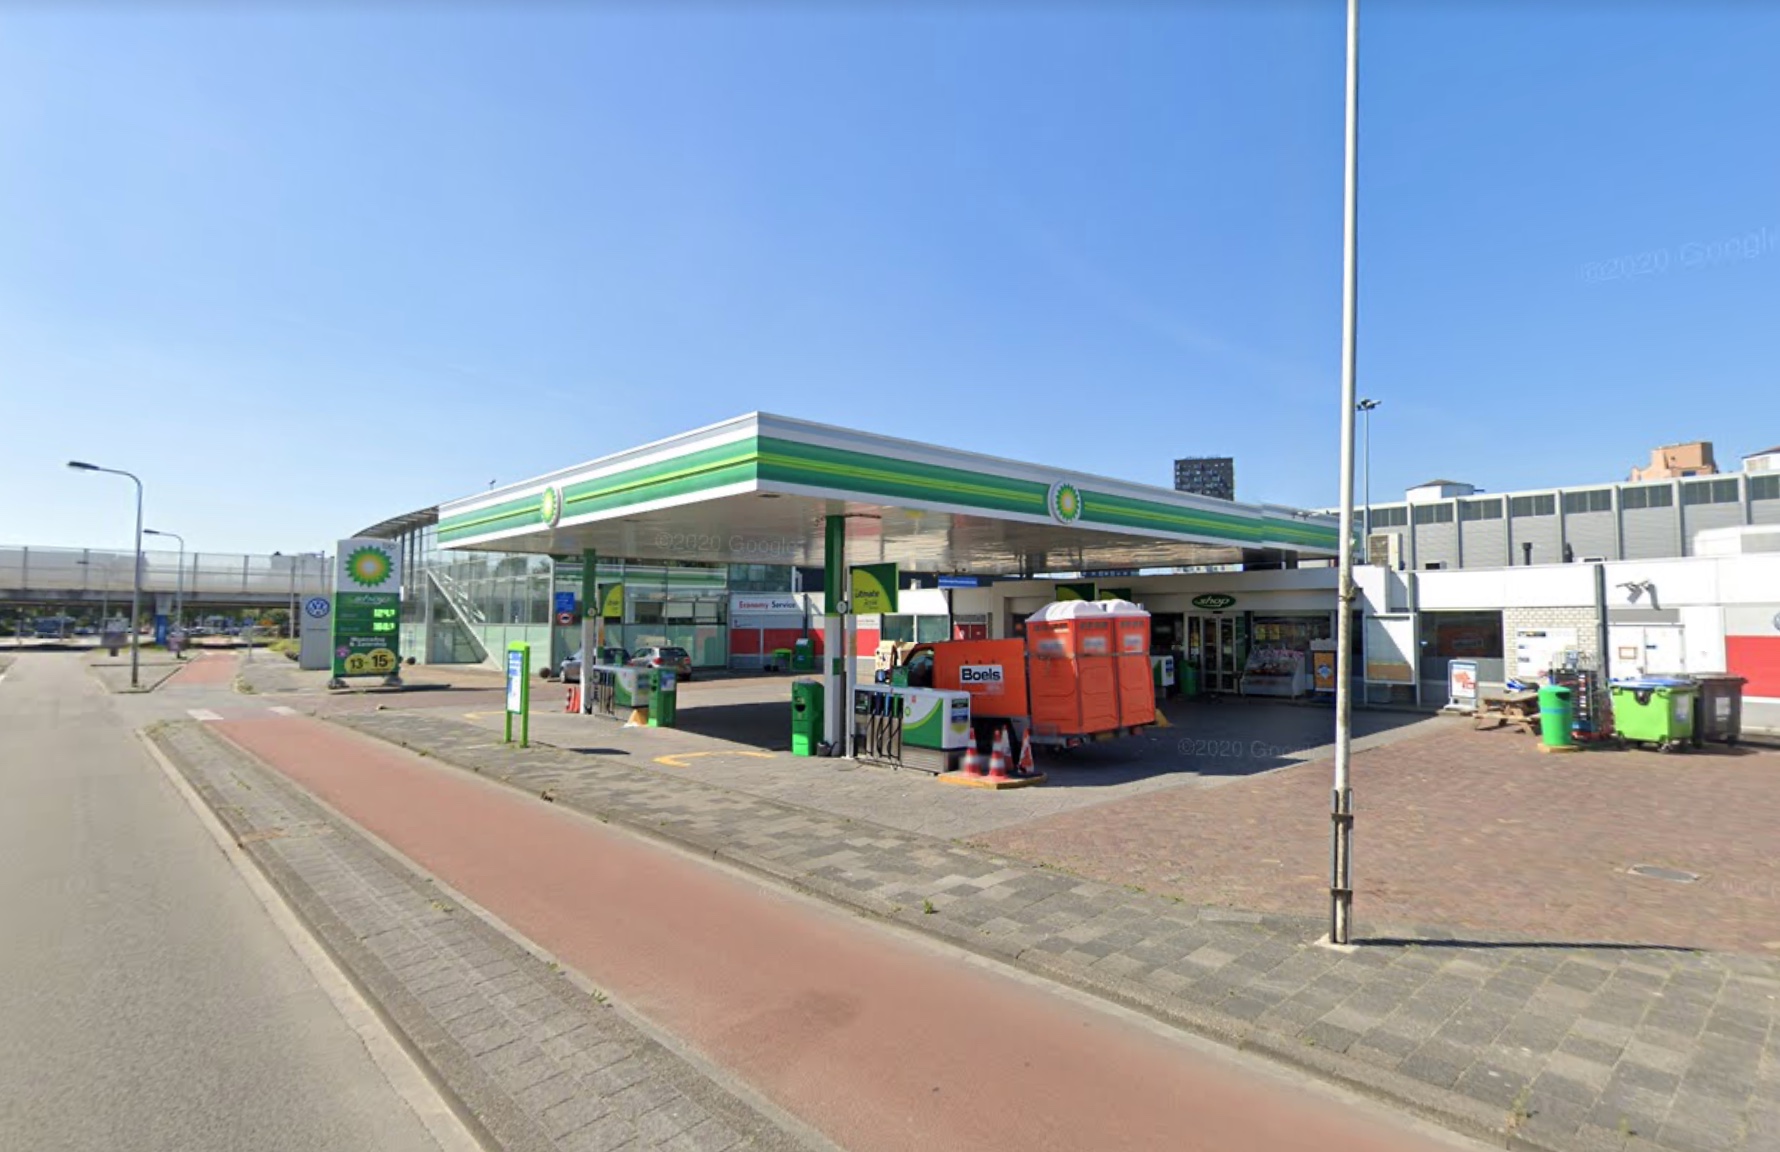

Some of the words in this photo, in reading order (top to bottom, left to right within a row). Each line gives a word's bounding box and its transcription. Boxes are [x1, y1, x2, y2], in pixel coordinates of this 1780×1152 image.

[739, 600, 769, 609] Economy
[771, 600, 796, 609] Service
[961, 668, 1001, 681] Boels
